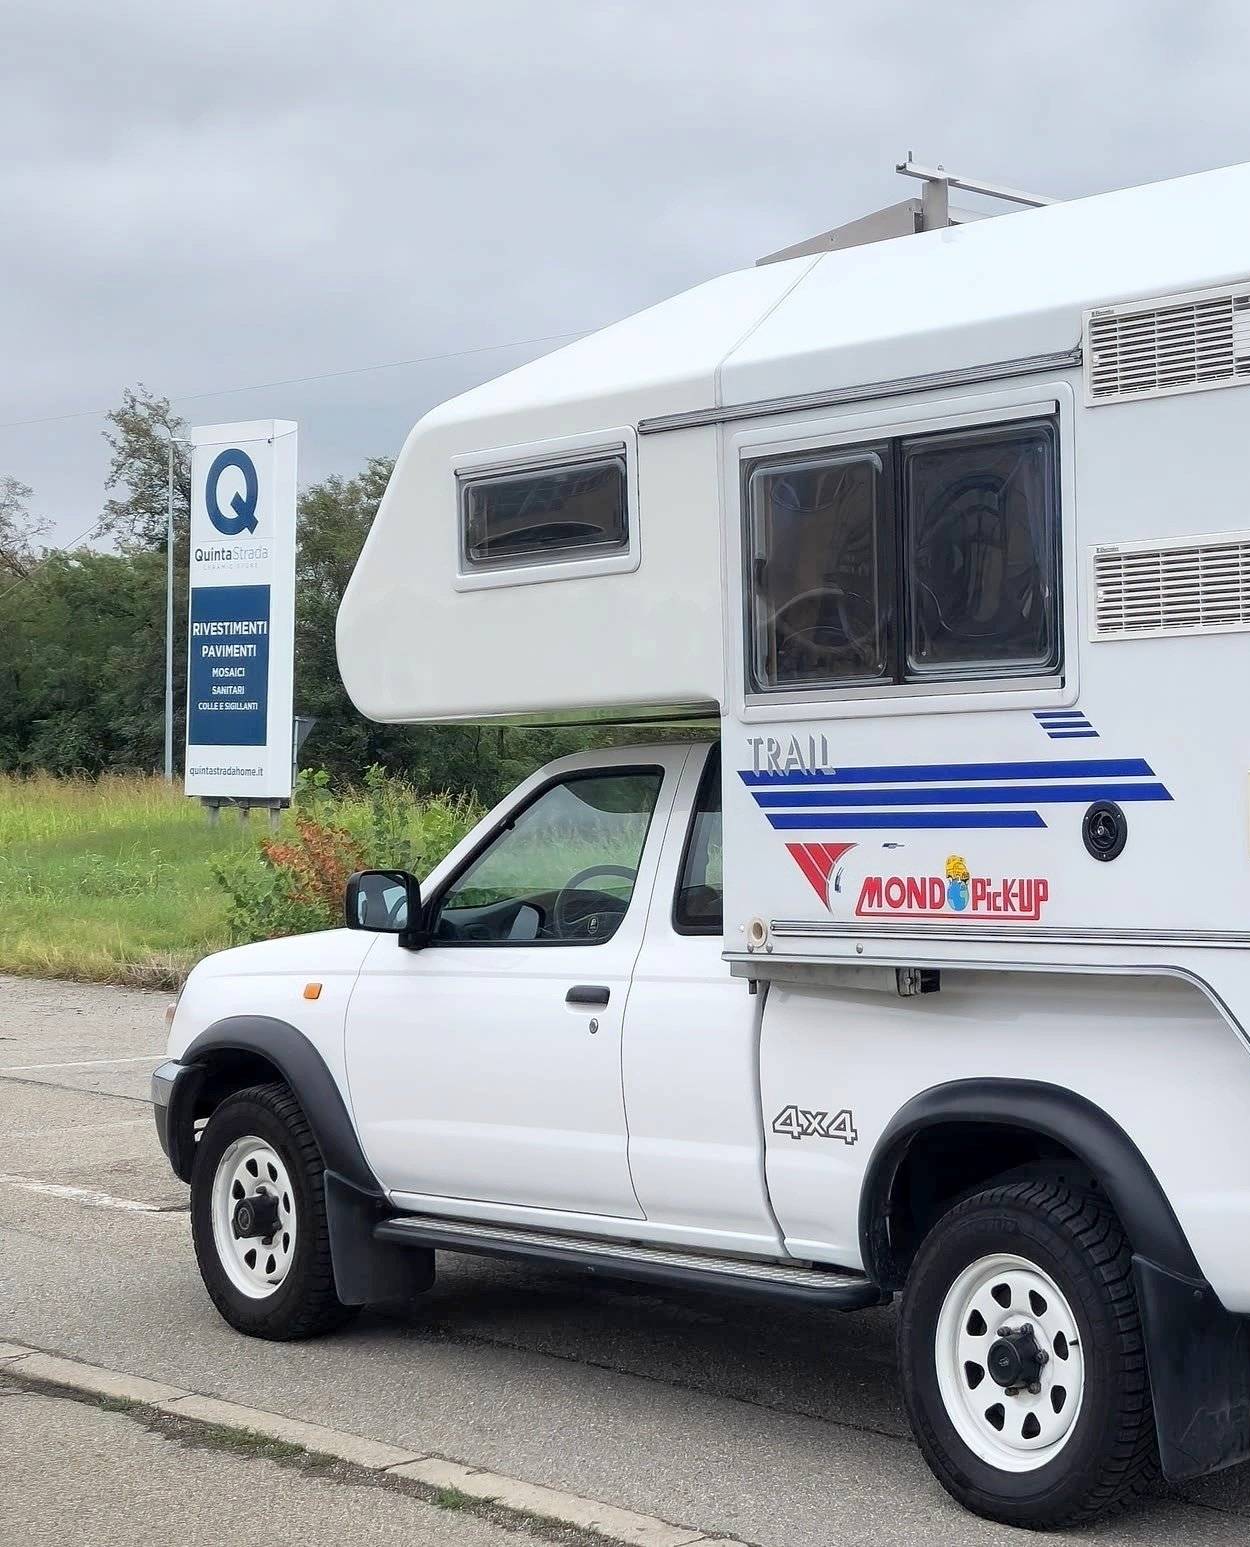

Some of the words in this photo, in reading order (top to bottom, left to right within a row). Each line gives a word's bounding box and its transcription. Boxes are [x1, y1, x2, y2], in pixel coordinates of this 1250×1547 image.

[194, 546, 269, 562] QuintaStrada
[192, 620, 268, 636] RIVESTIMENTI
[201, 644, 257, 658] PAVIMENTI
[211, 667, 246, 678] MOSAICI
[211, 685, 245, 695] SANITARI
[198, 702, 219, 711] COLLE
[219, 702, 225, 711] E
[225, 702, 259, 711] SIGILLANTI
[746, 733, 837, 778] TRAIL
[189, 765, 264, 777] quintastradahome.it
[771, 1104, 859, 1146] 4x4
